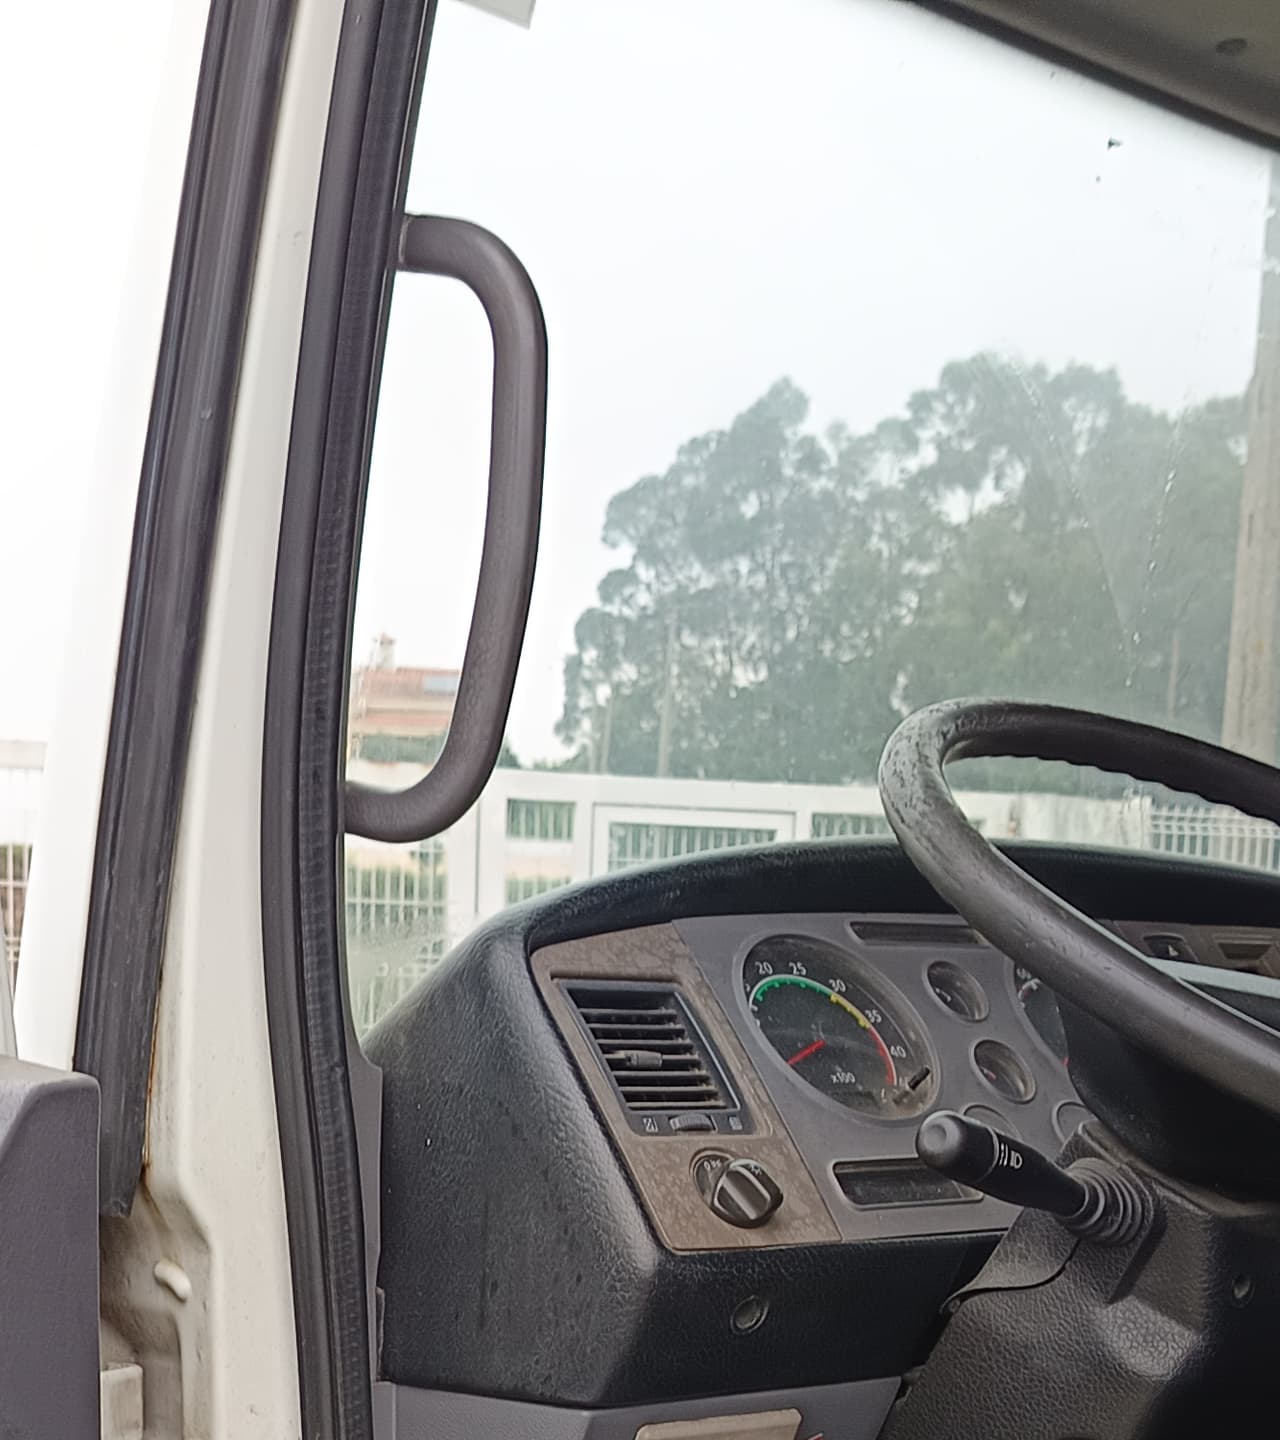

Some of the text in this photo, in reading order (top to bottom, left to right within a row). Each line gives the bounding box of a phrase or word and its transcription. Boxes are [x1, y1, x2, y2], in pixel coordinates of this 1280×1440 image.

[754, 961, 774, 975] 20
[788, 961, 808, 976] 25
[828, 979, 847, 993] 30
[864, 1009, 883, 1023] 35
[890, 1045, 907, 1059] 40
[830, 1071, 856, 1085] x100
